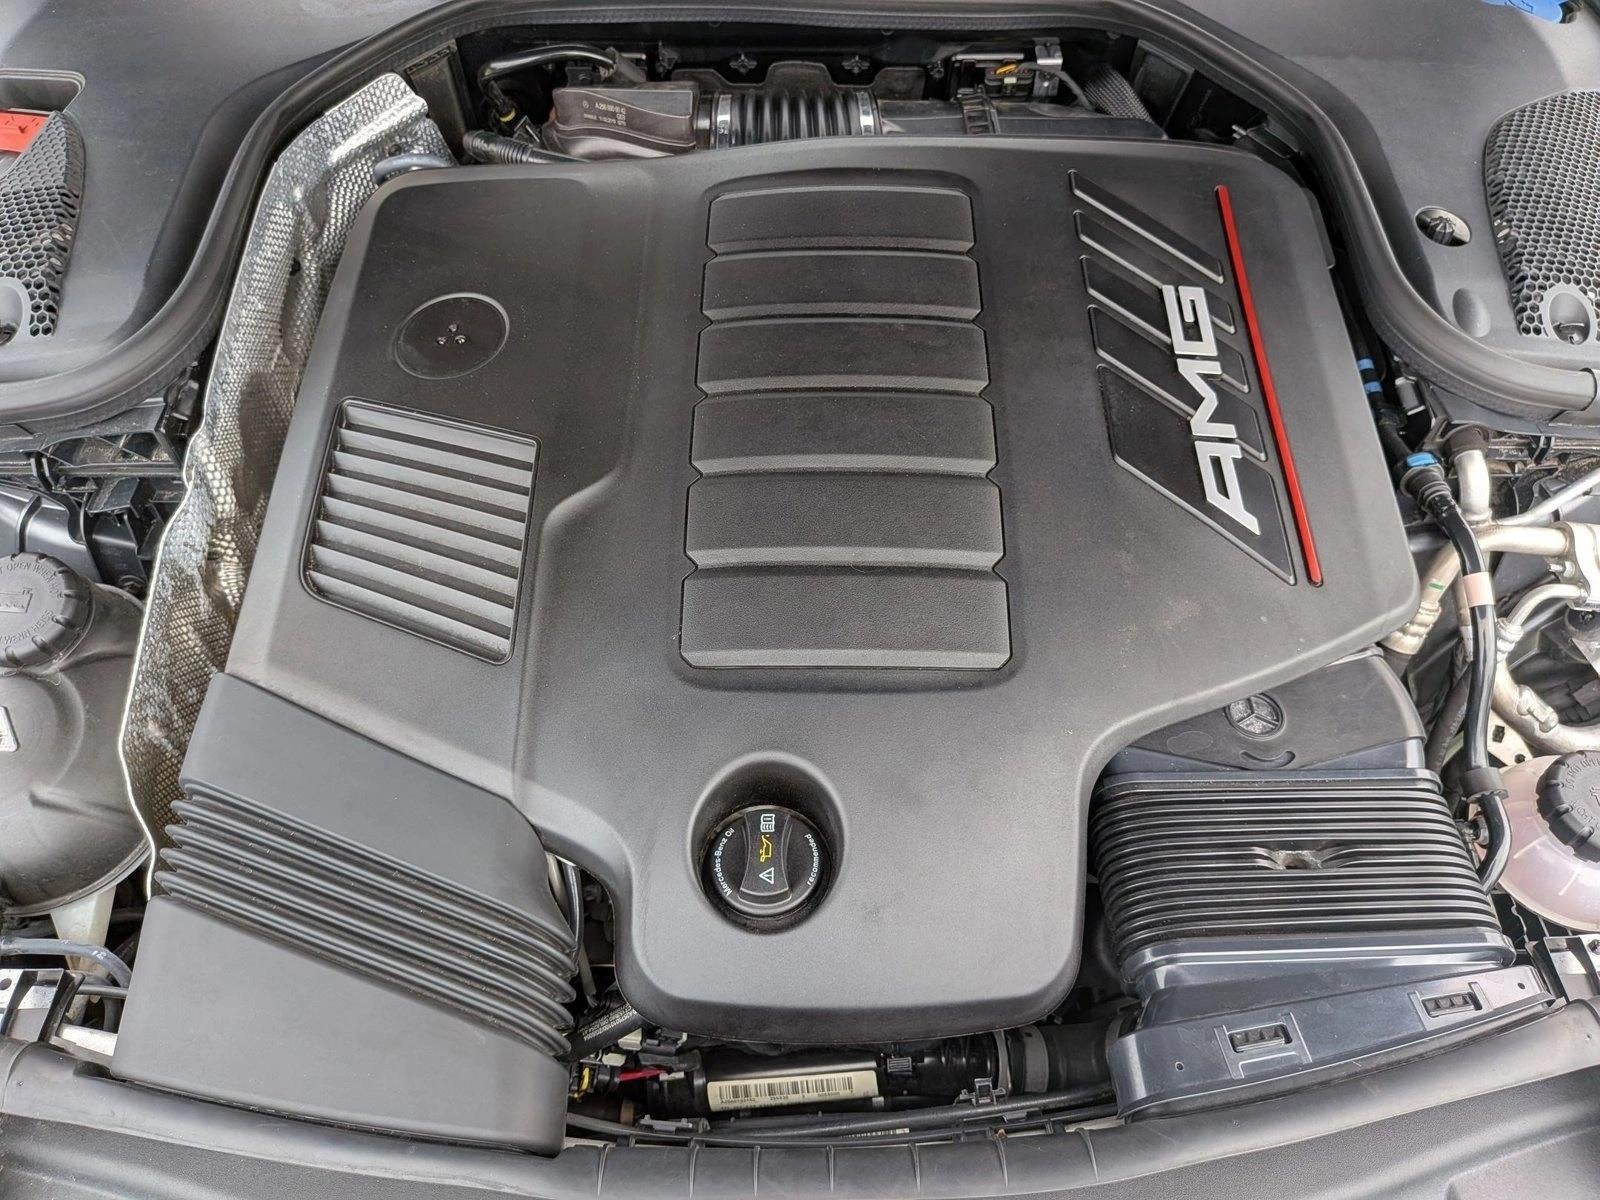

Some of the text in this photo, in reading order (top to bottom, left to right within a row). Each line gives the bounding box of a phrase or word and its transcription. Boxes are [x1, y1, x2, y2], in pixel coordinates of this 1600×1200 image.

[1162, 284, 1261, 536] AMG
[714, 827, 735, 897] Mercedes-Benz Oil
[804, 833, 820, 886] recommended
